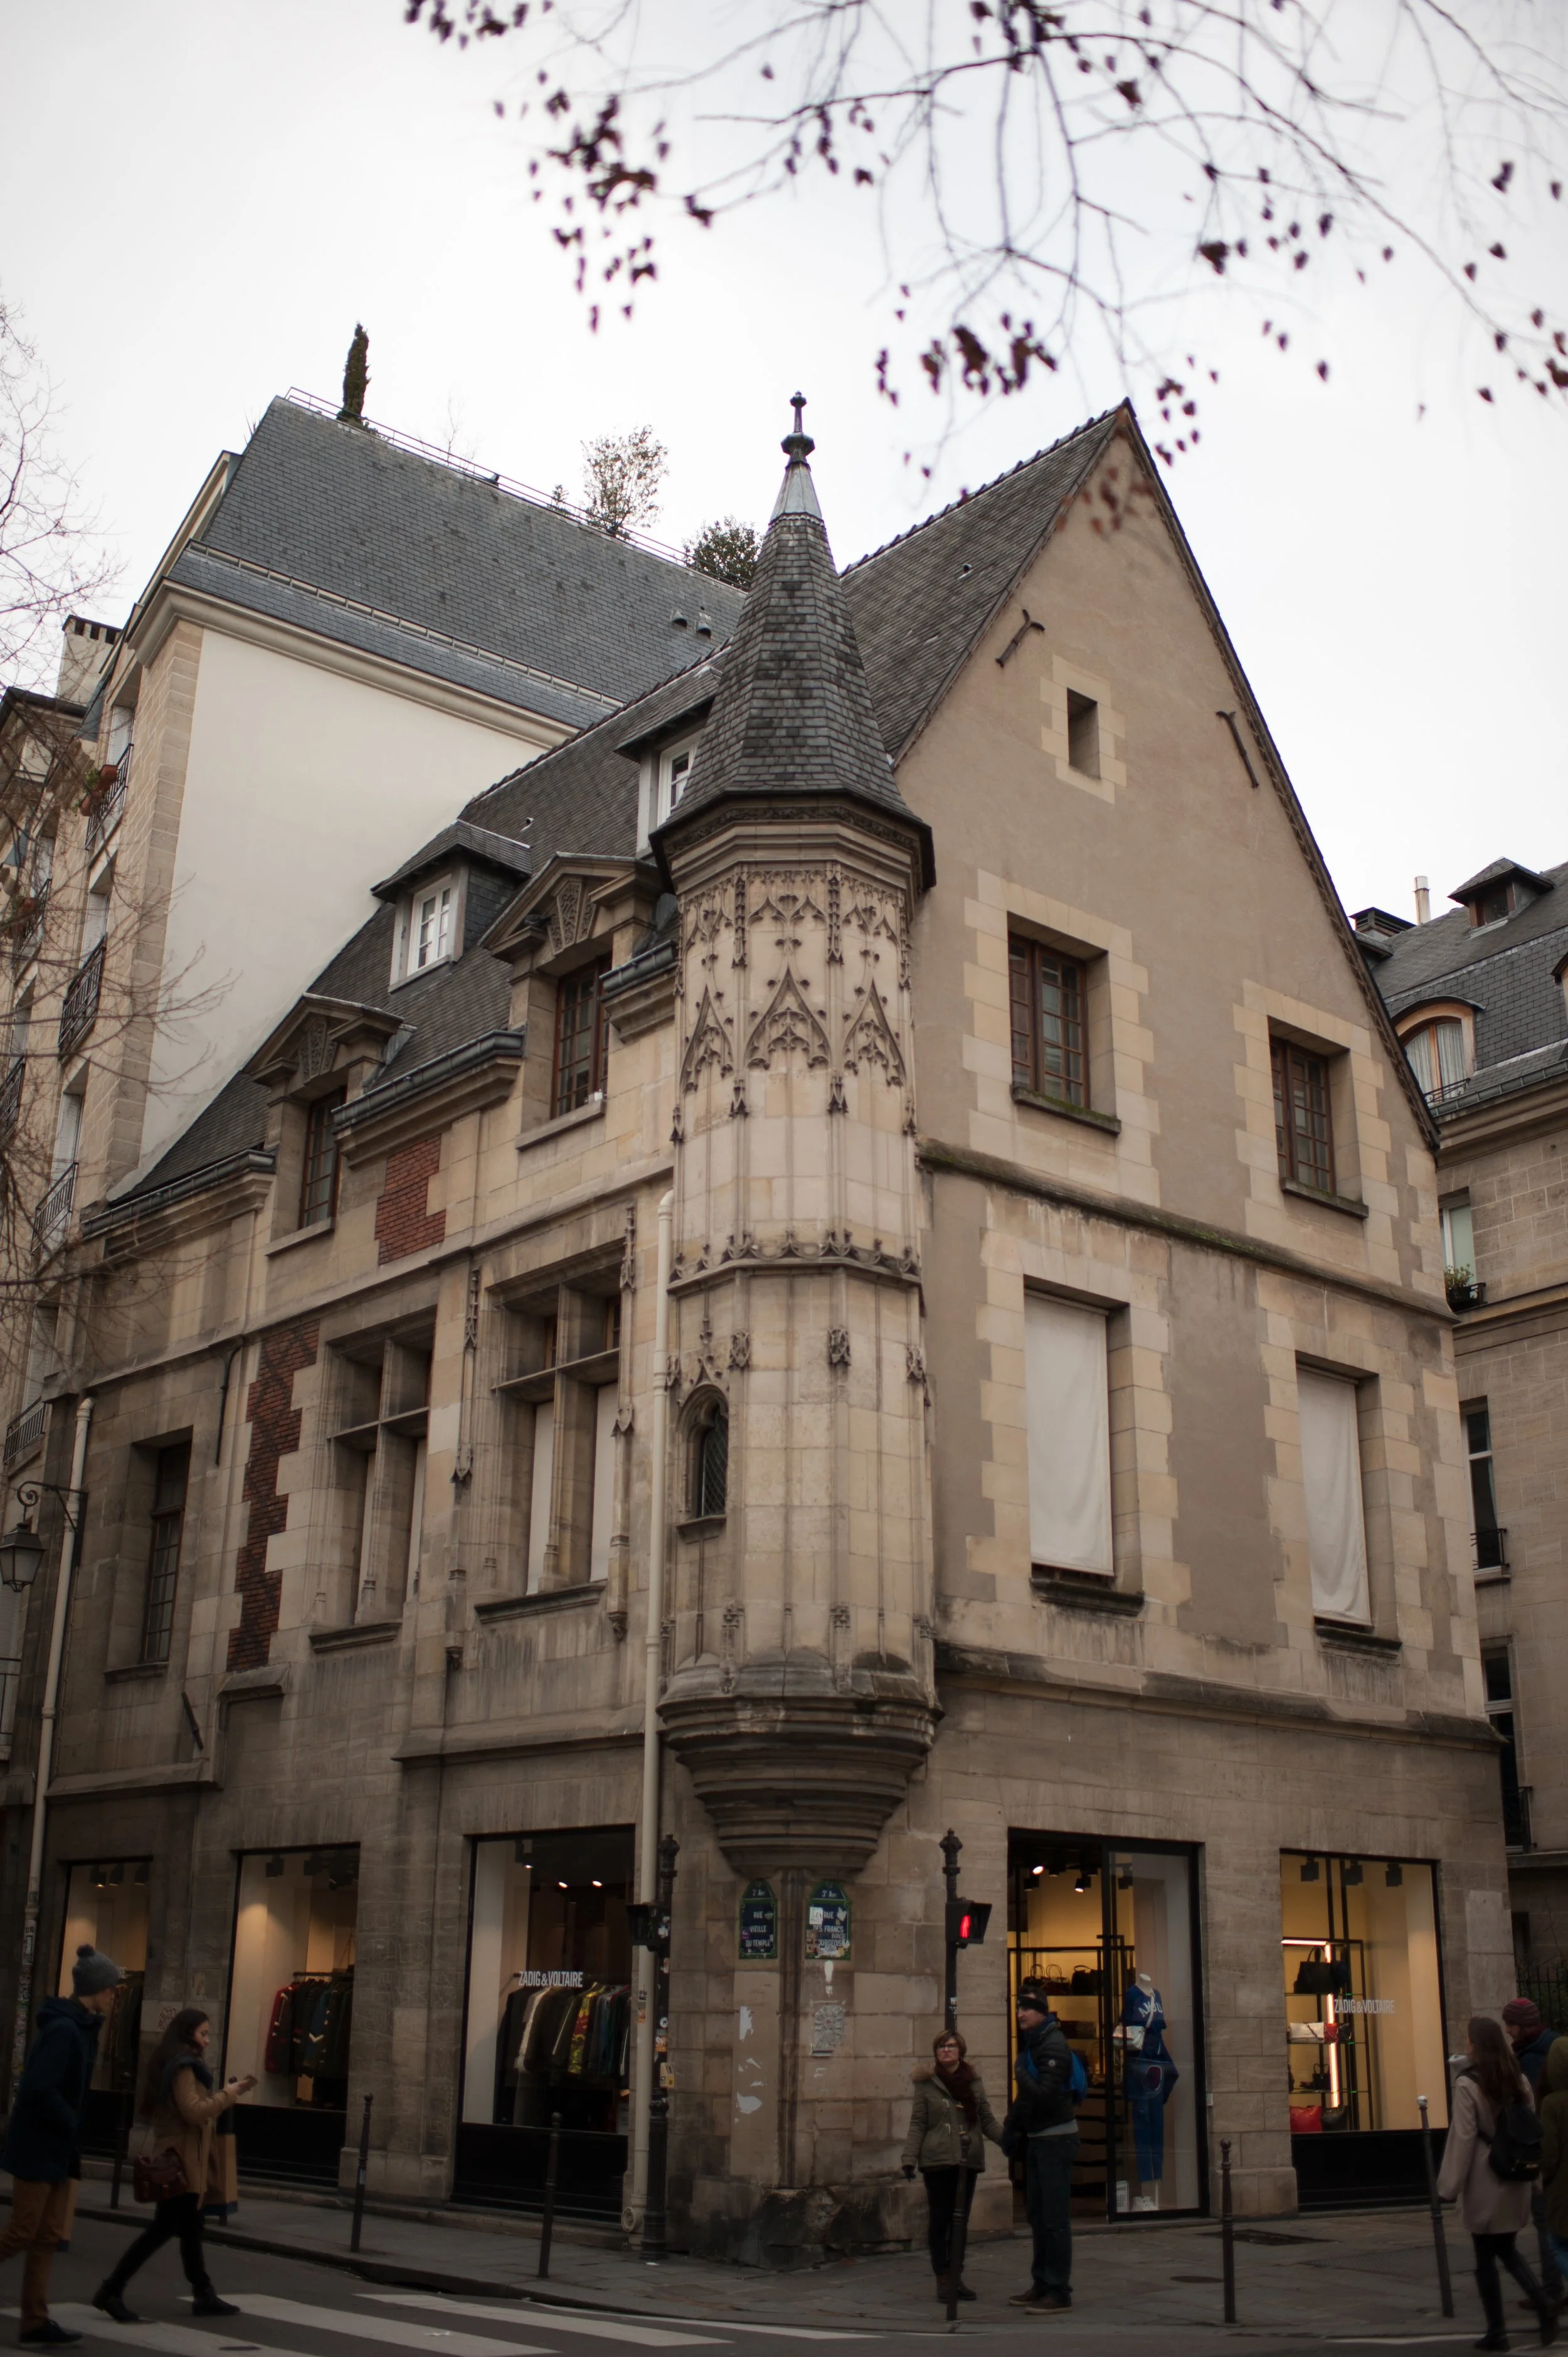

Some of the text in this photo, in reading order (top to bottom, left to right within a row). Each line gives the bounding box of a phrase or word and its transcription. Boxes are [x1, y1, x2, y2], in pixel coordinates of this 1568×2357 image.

[824, 1911, 834, 1919] RUE
[750, 1925, 767, 1933] VIEILLE
[745, 1939, 770, 1947] DU TEMPLE
